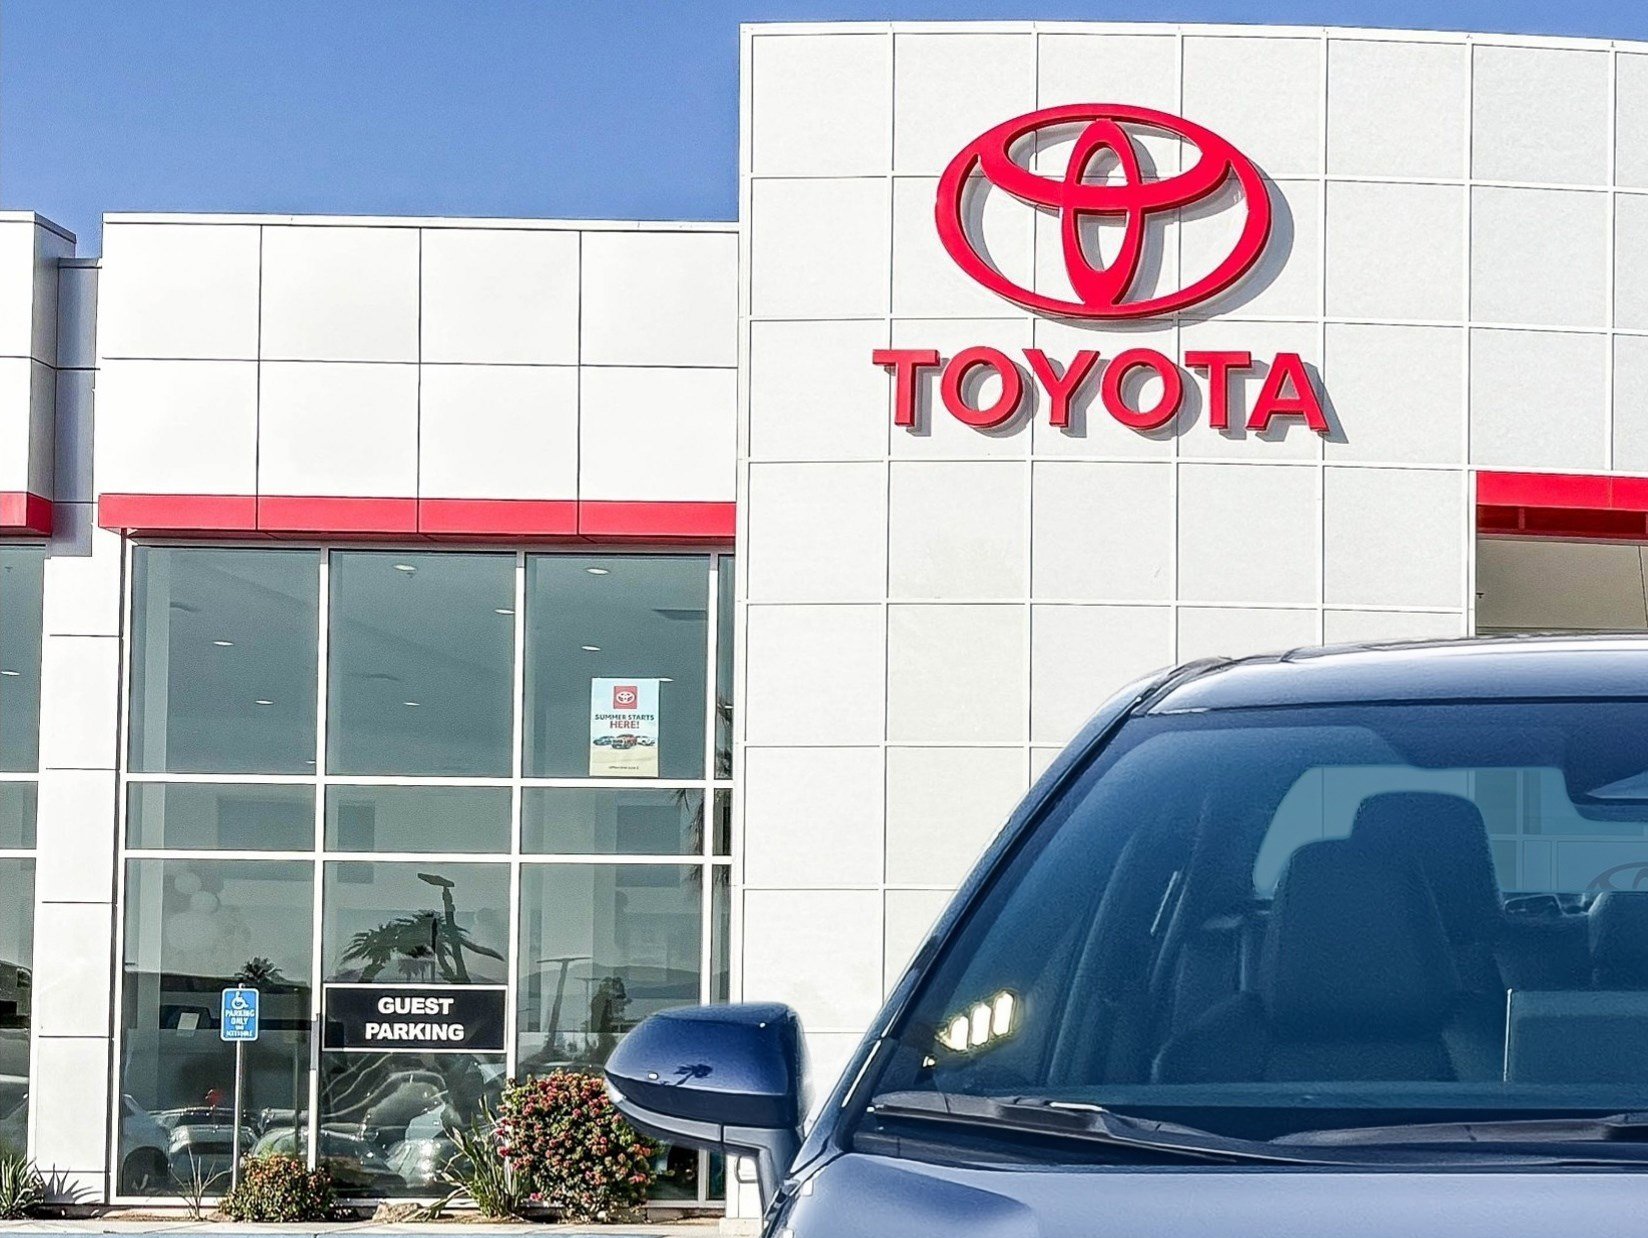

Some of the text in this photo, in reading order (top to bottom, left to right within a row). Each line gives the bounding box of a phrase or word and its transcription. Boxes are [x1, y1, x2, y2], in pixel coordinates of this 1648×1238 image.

[873, 346, 1329, 432] TOYOTA
[609, 720, 640, 729] HERE!
[377, 997, 454, 1015] GUEST
[365, 1022, 464, 1041] PARKING
